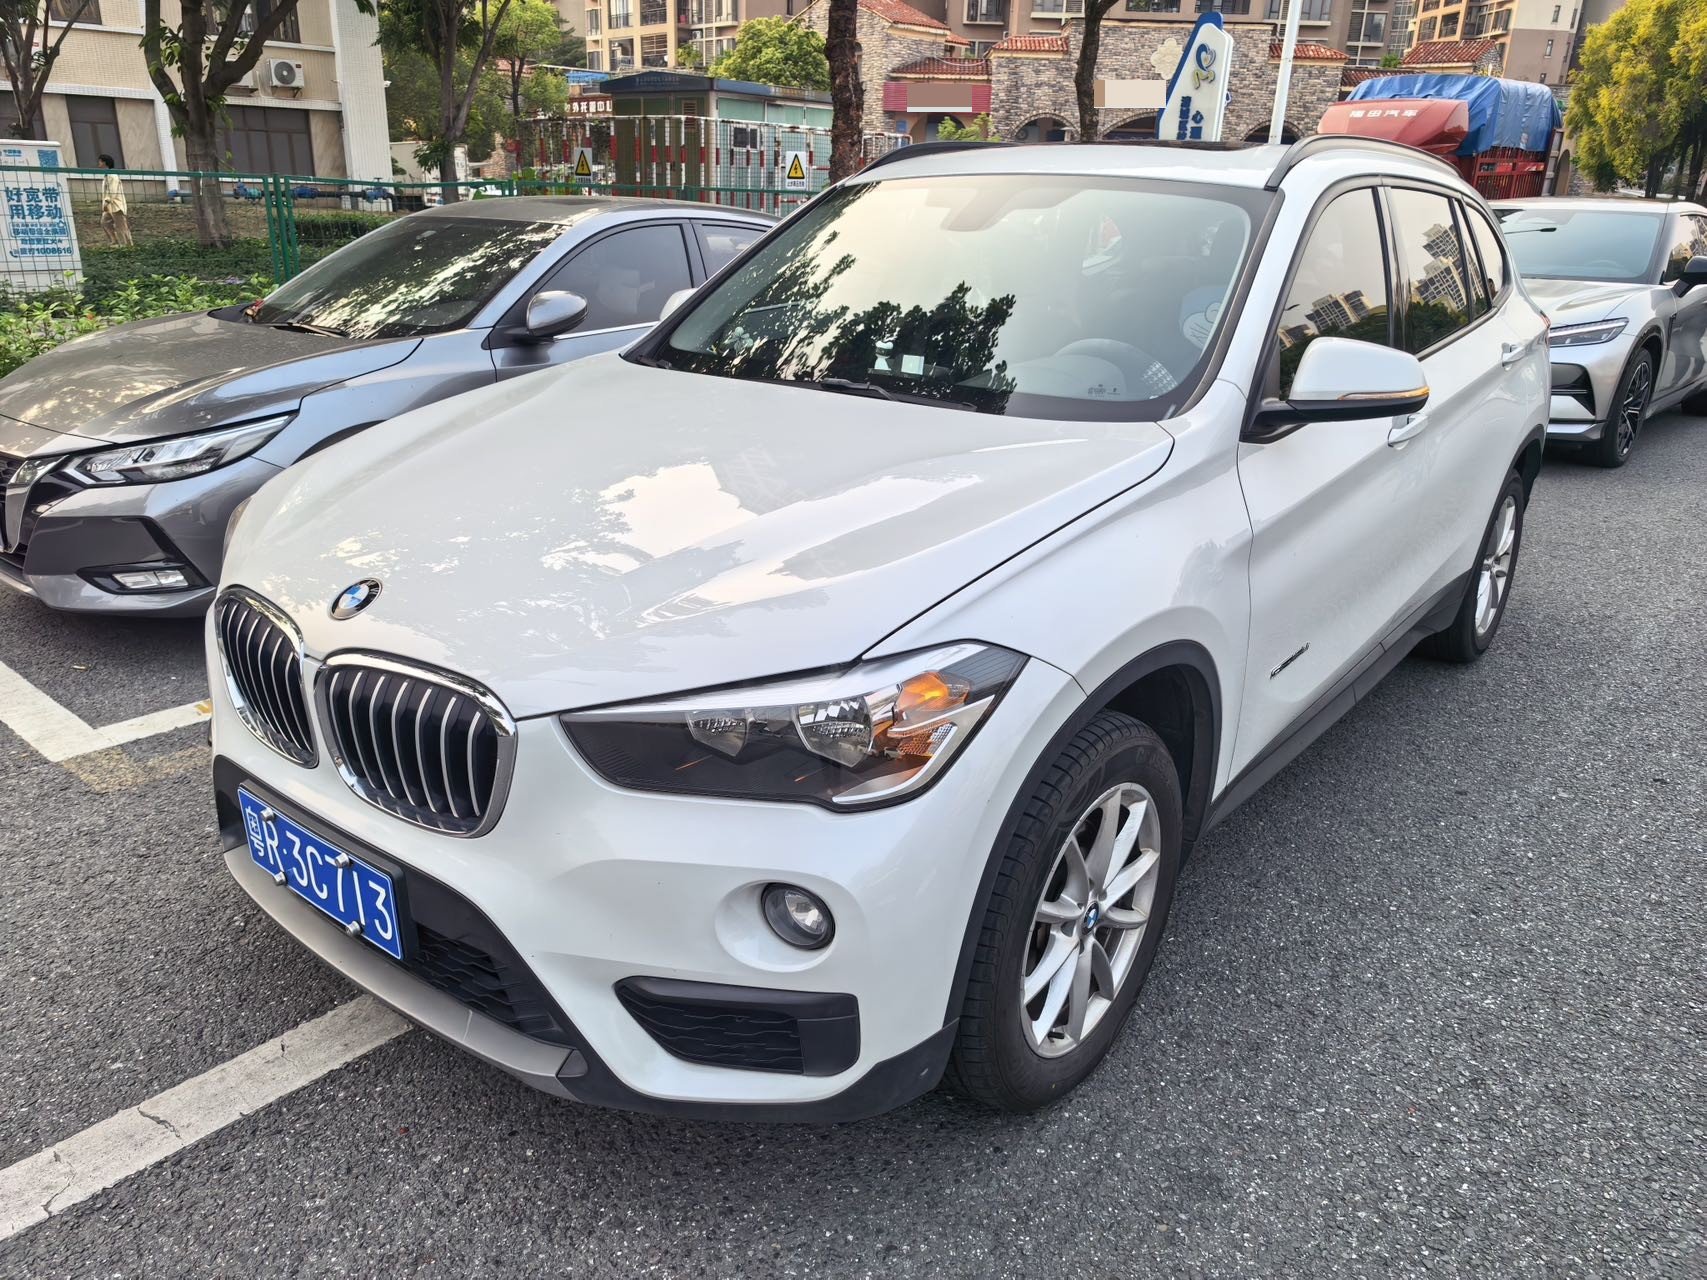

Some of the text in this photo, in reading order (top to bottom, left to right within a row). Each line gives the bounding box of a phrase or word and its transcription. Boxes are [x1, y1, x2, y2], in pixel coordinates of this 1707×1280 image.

[5, 186, 60, 203] 好宽带
[10, 204, 63, 220] 用移动
